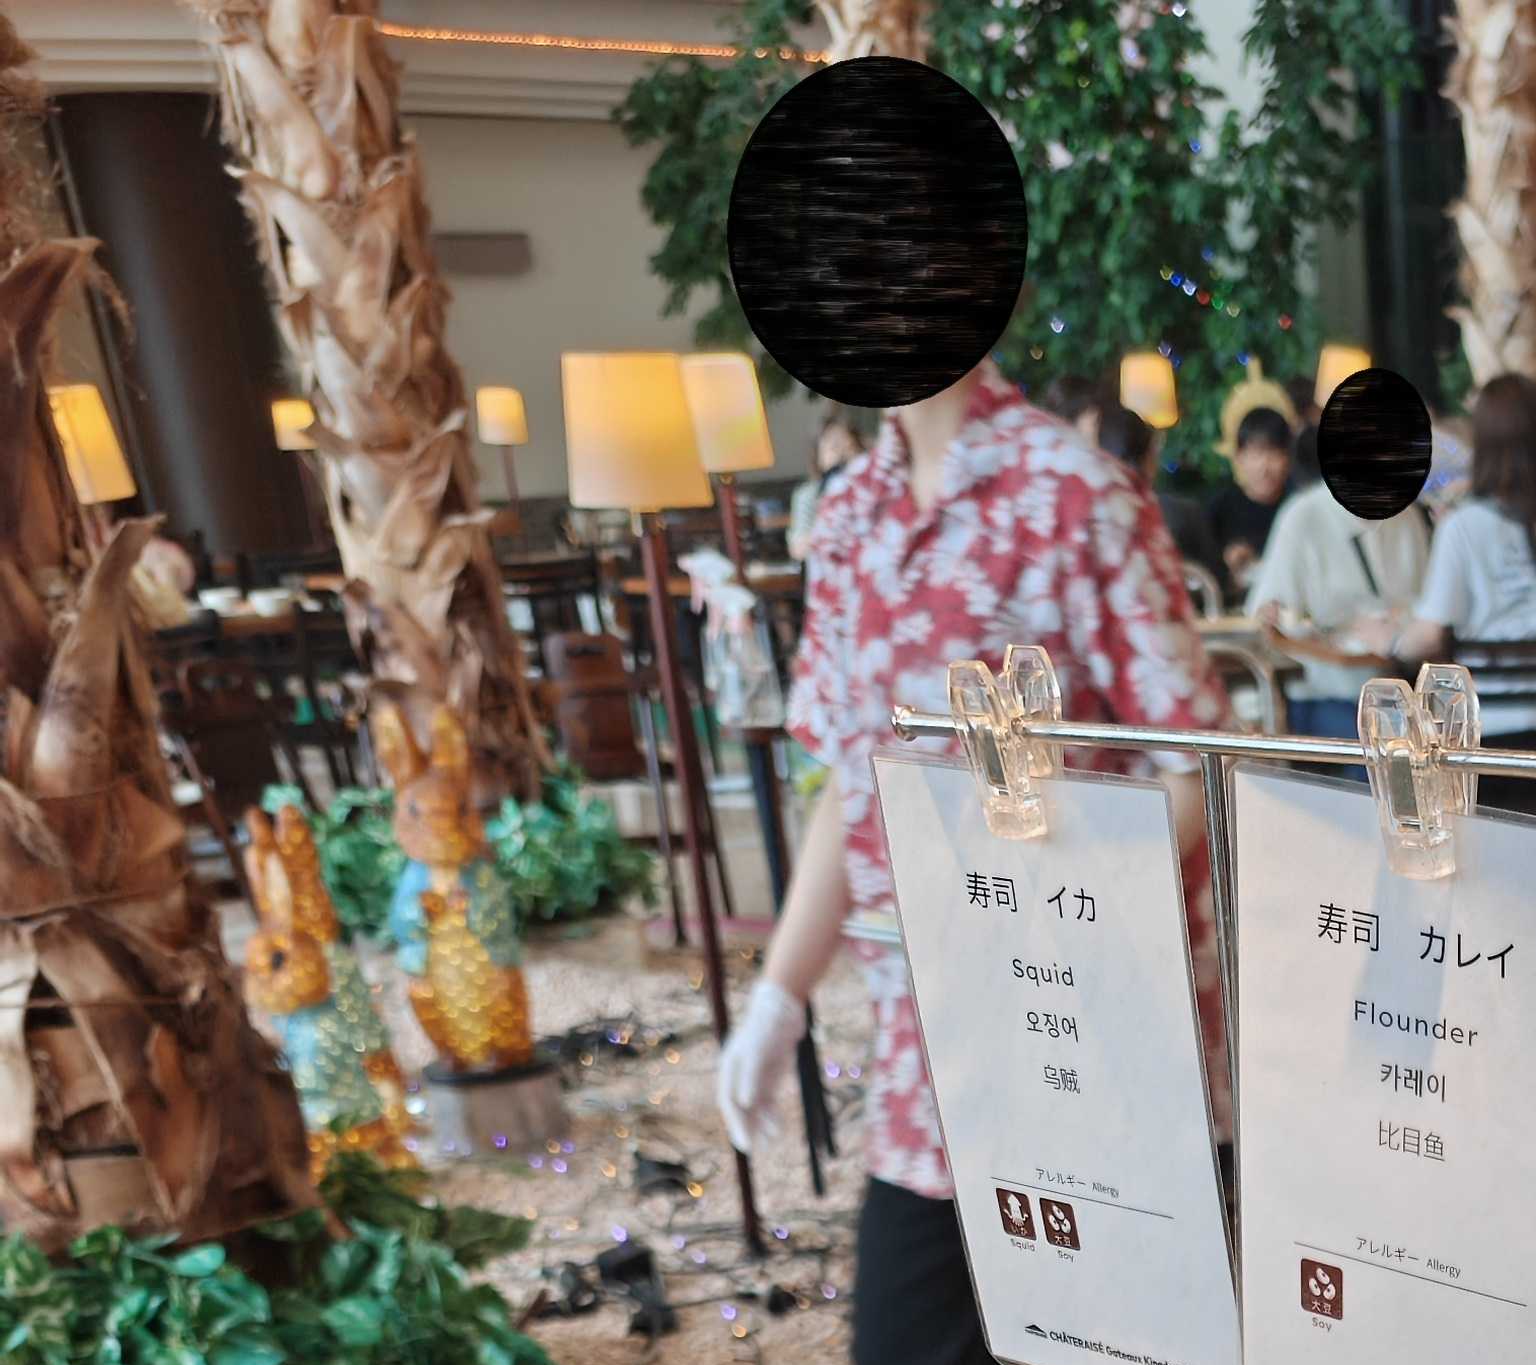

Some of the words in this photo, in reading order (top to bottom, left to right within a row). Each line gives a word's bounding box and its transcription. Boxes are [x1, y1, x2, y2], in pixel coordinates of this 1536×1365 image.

[966, 871, 1018, 913] 寿司
[1047, 886, 1096, 922] イカ
[1317, 903, 1380, 952] 寿司
[1419, 925, 1514, 979] カレイ
[1012, 957, 1075, 988] Squid
[1026, 1011, 1079, 1043] 오징어
[1354, 1000, 1479, 1047] Flounder
[1043, 1064, 1081, 1094] 乌贼
[1380, 1063, 1446, 1103] 카레이
[1378, 1120, 1445, 1162] 比目鱼
[1355, 1236, 1419, 1262] アレルギー
[1426, 1258, 1461, 1279] Allergy
[1311, 1300, 1332, 1314] 大豆
[1311, 1317, 1333, 1332] Soy
